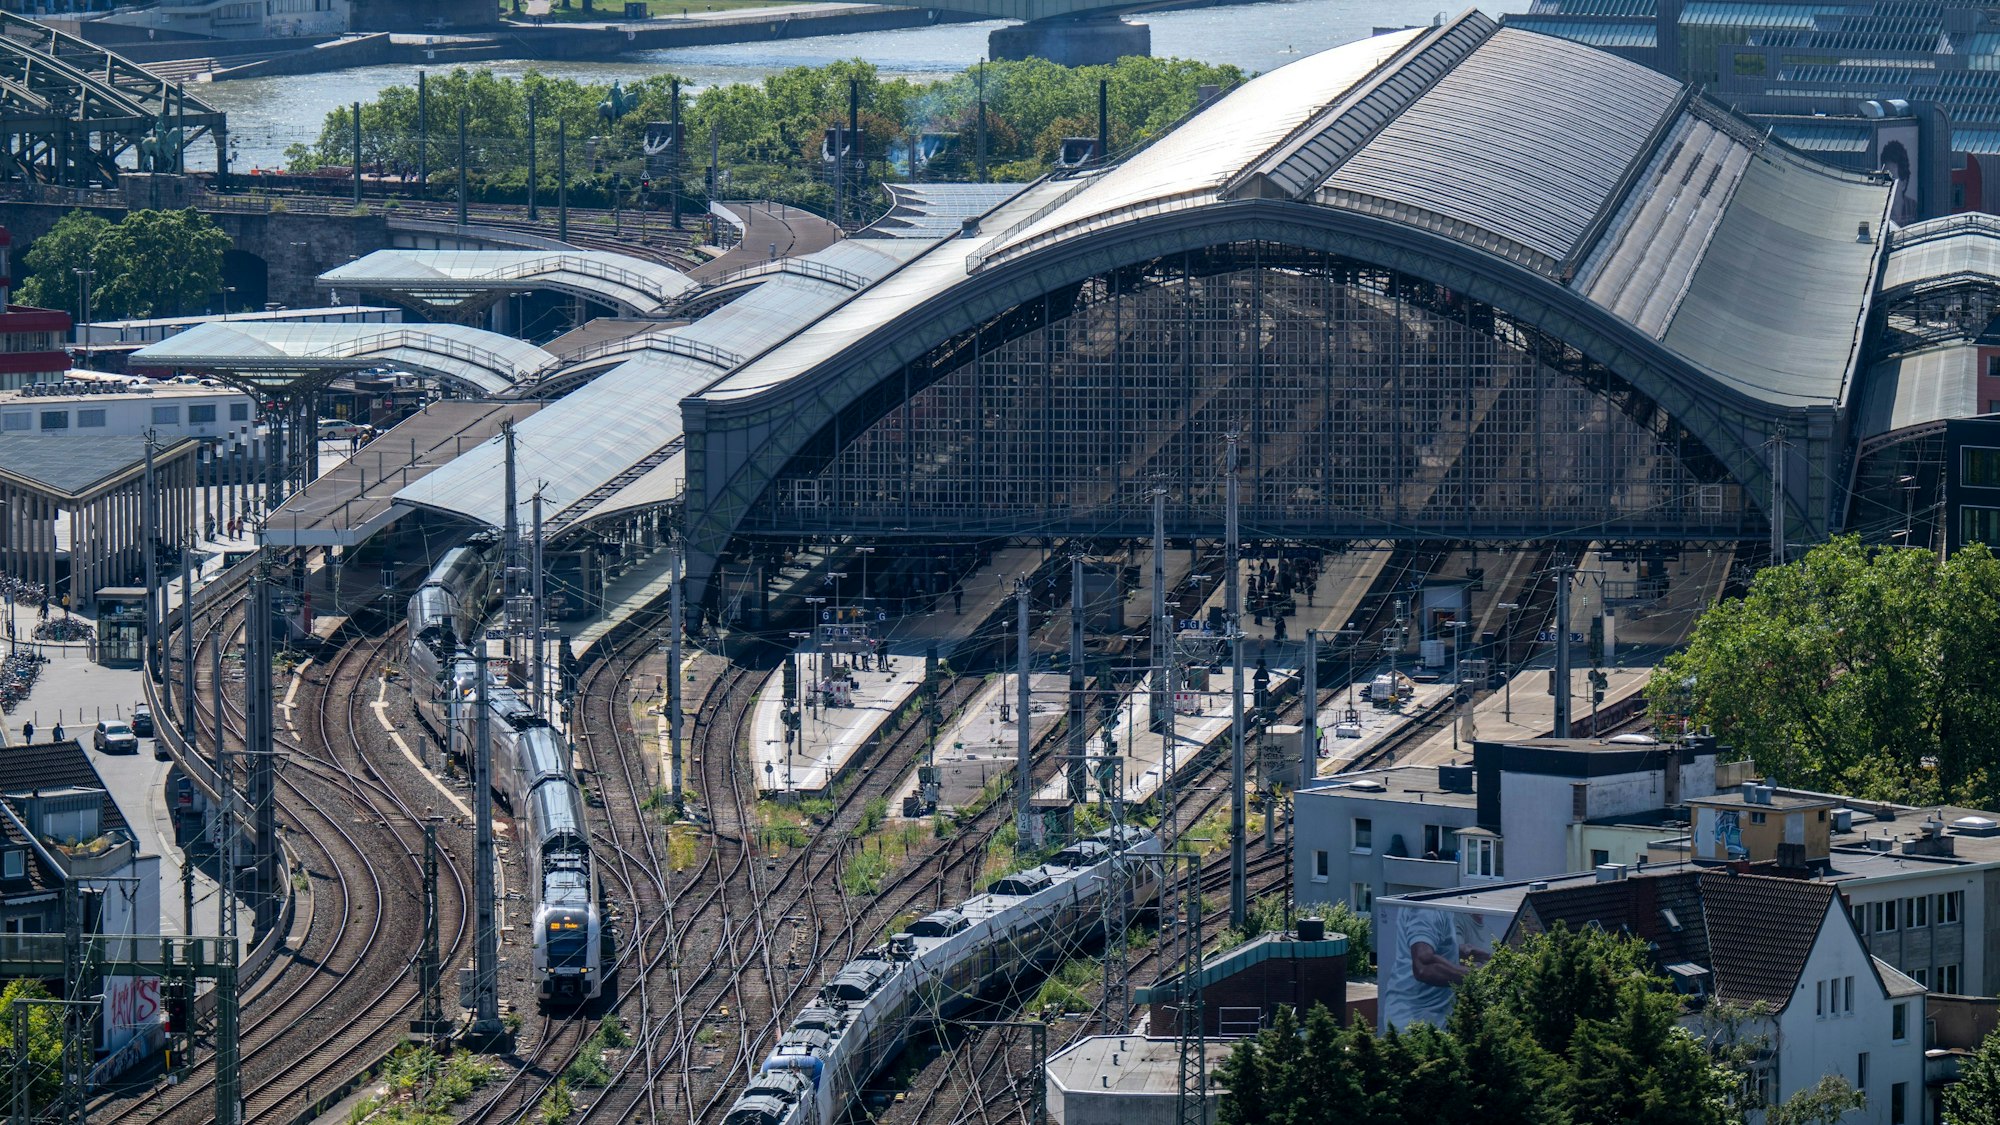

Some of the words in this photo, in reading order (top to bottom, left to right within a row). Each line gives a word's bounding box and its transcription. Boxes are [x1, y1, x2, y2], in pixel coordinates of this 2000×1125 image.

[823, 612, 829, 620] G
[879, 612, 886, 621] G
[1180, 620, 1186, 629] 5
[1190, 621, 1196, 629] G
[1540, 633, 1546, 641] 3
[1578, 633, 1583, 641] 2
